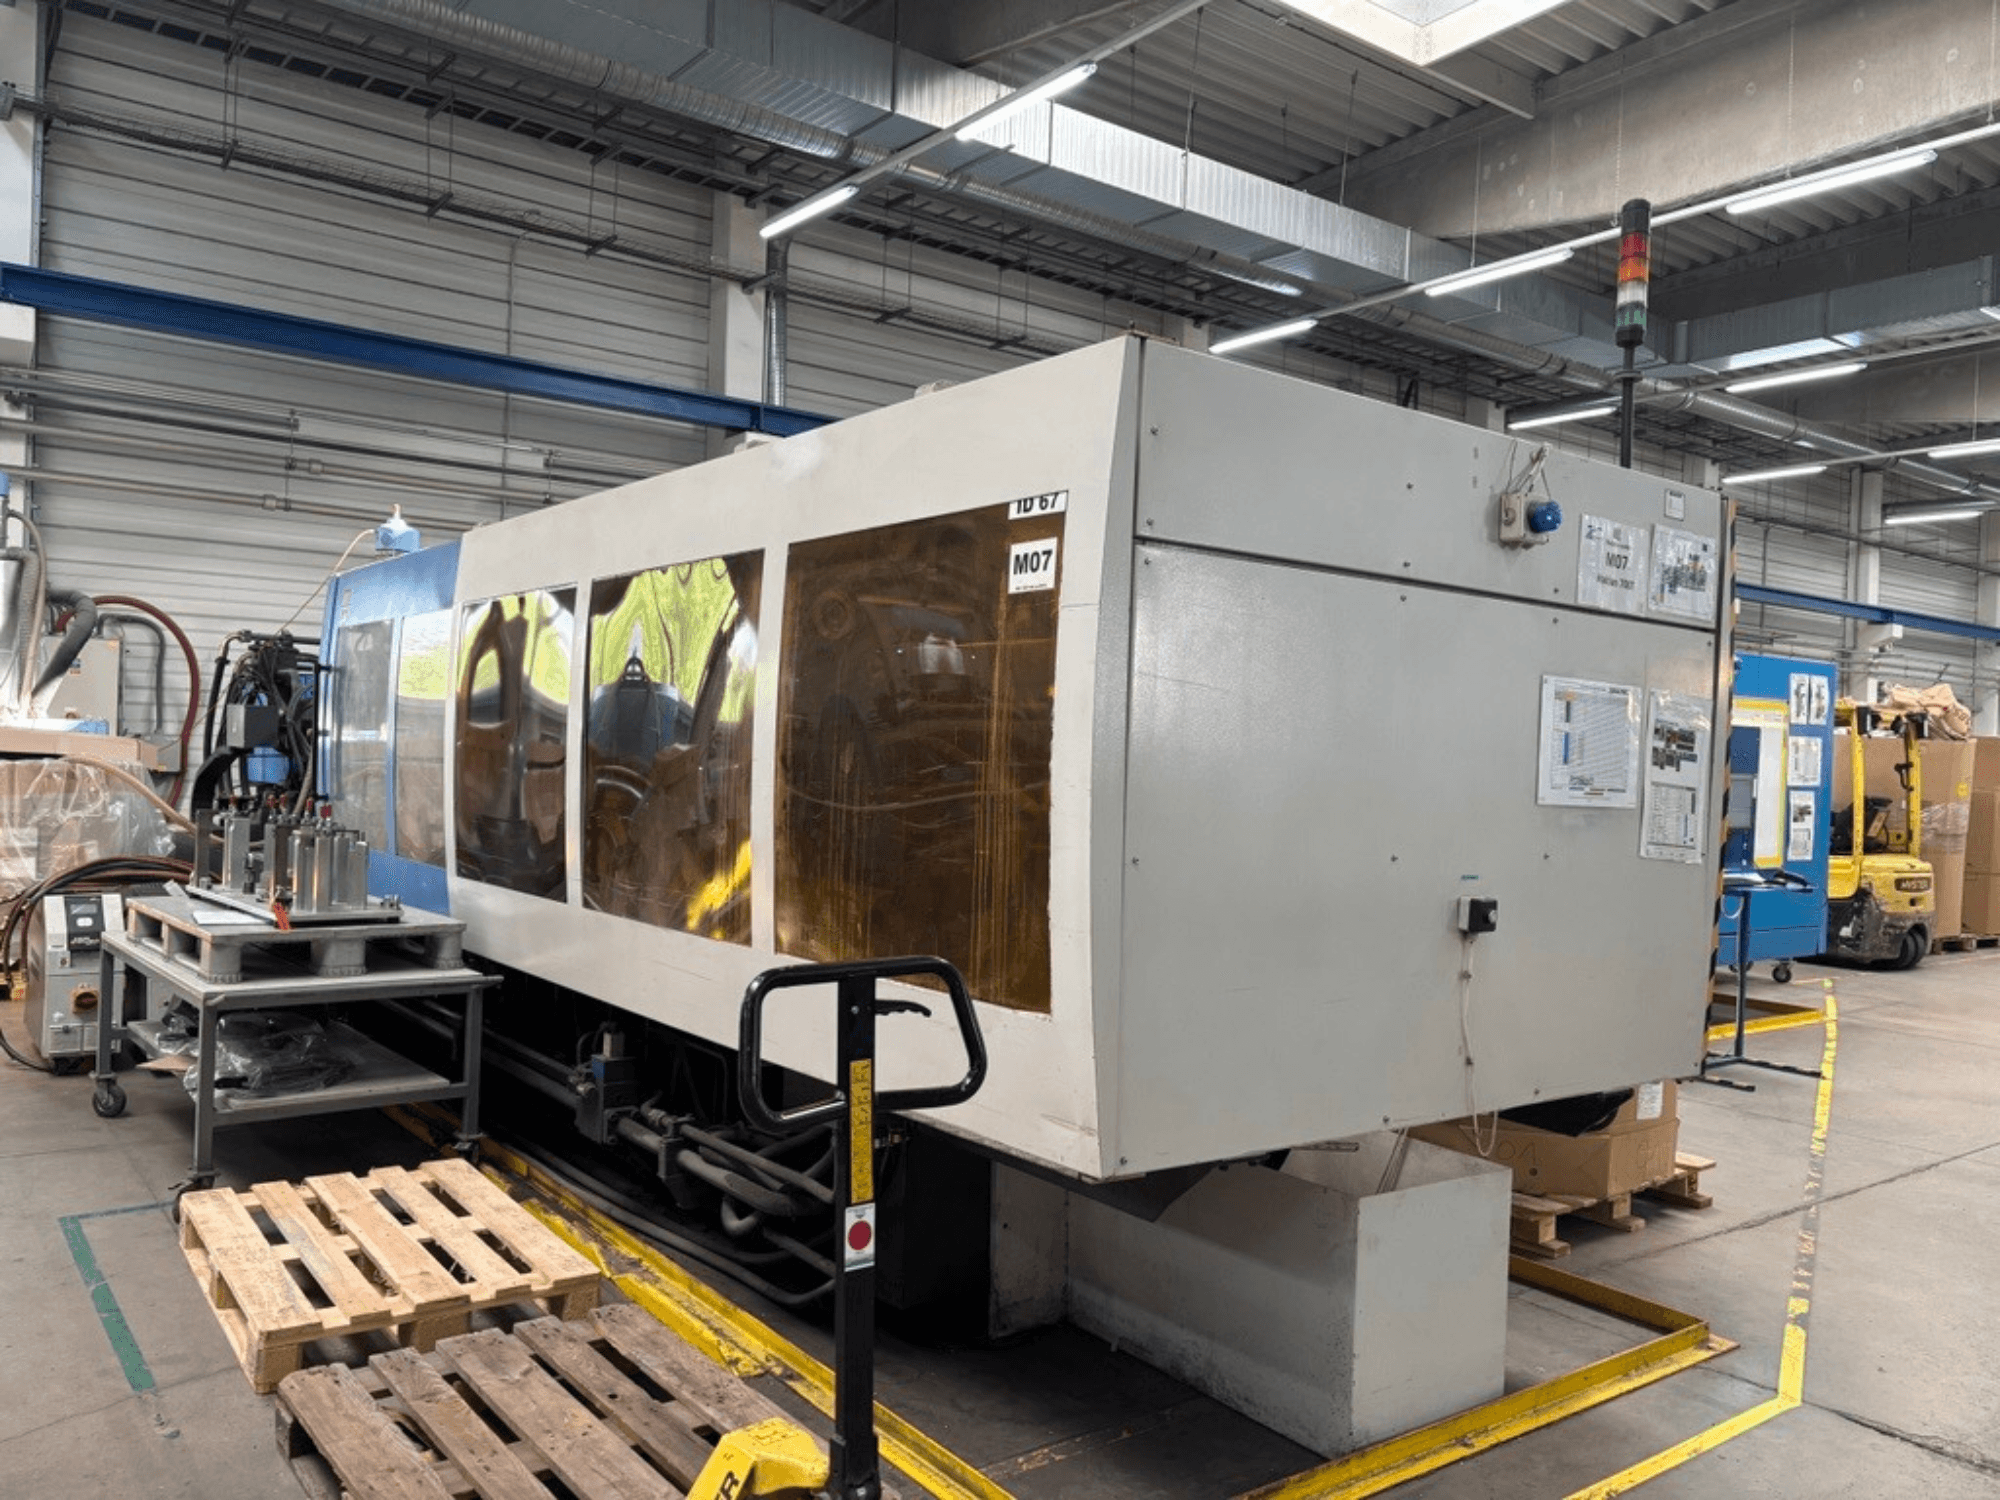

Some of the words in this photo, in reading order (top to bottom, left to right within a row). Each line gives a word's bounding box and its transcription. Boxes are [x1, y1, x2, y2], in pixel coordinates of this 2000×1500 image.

[1016, 498, 1034, 514] ID
[1013, 549, 1053, 575] M07
[1605, 552, 1629, 570] M07
